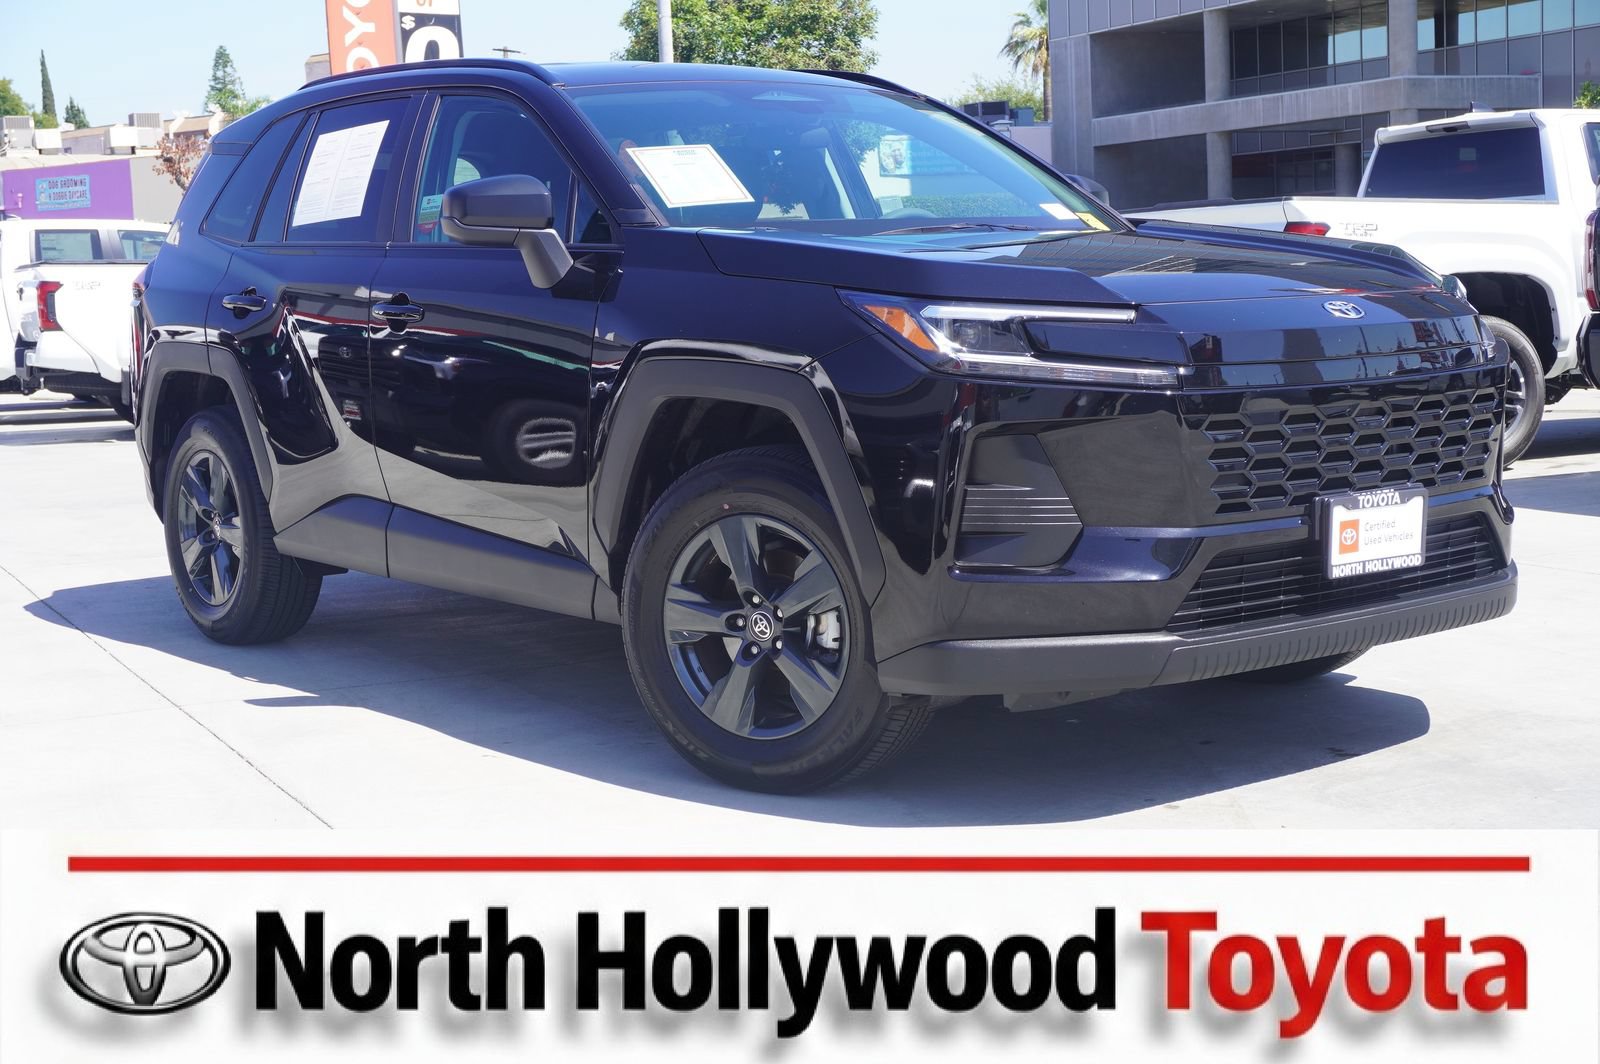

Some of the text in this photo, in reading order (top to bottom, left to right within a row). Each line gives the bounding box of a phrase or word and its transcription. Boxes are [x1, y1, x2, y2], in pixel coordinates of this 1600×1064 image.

[1357, 491, 1401, 509] TOYOTA
[1363, 519, 1397, 532] Certified
[1363, 530, 1414, 546] Used Vehicles
[1332, 554, 1422, 578] NORTH HOLLYWOOD
